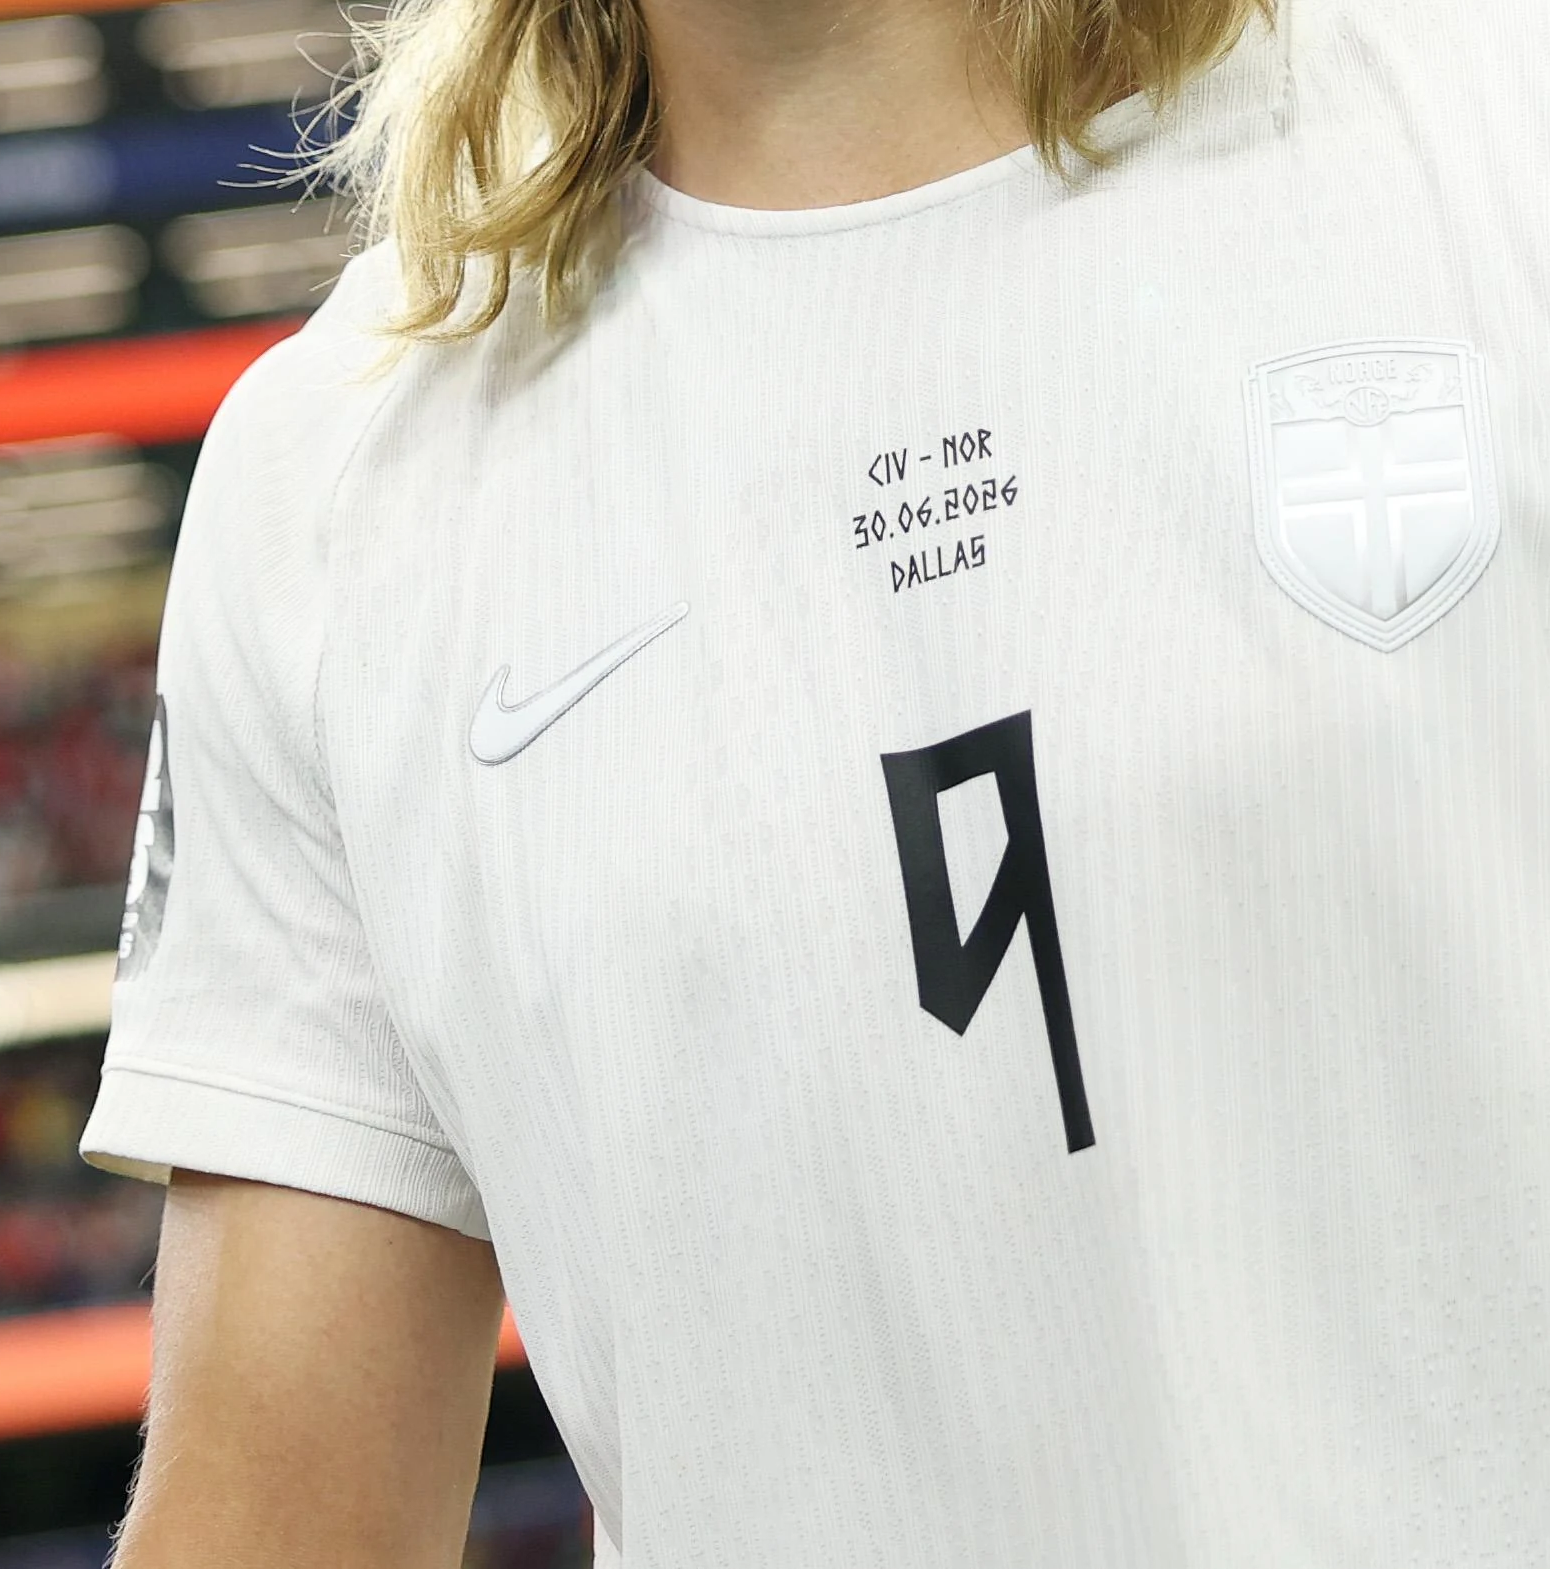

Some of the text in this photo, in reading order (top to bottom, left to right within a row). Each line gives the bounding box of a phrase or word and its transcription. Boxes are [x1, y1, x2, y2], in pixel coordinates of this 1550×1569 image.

[1329, 358, 1398, 384] NORGE
[868, 448, 907, 486] CIV
[943, 429, 992, 468] NOR
[853, 475, 1018, 549] 30.06.2026
[891, 535, 986, 593] DALLAS
[880, 709, 1096, 1154] 9
